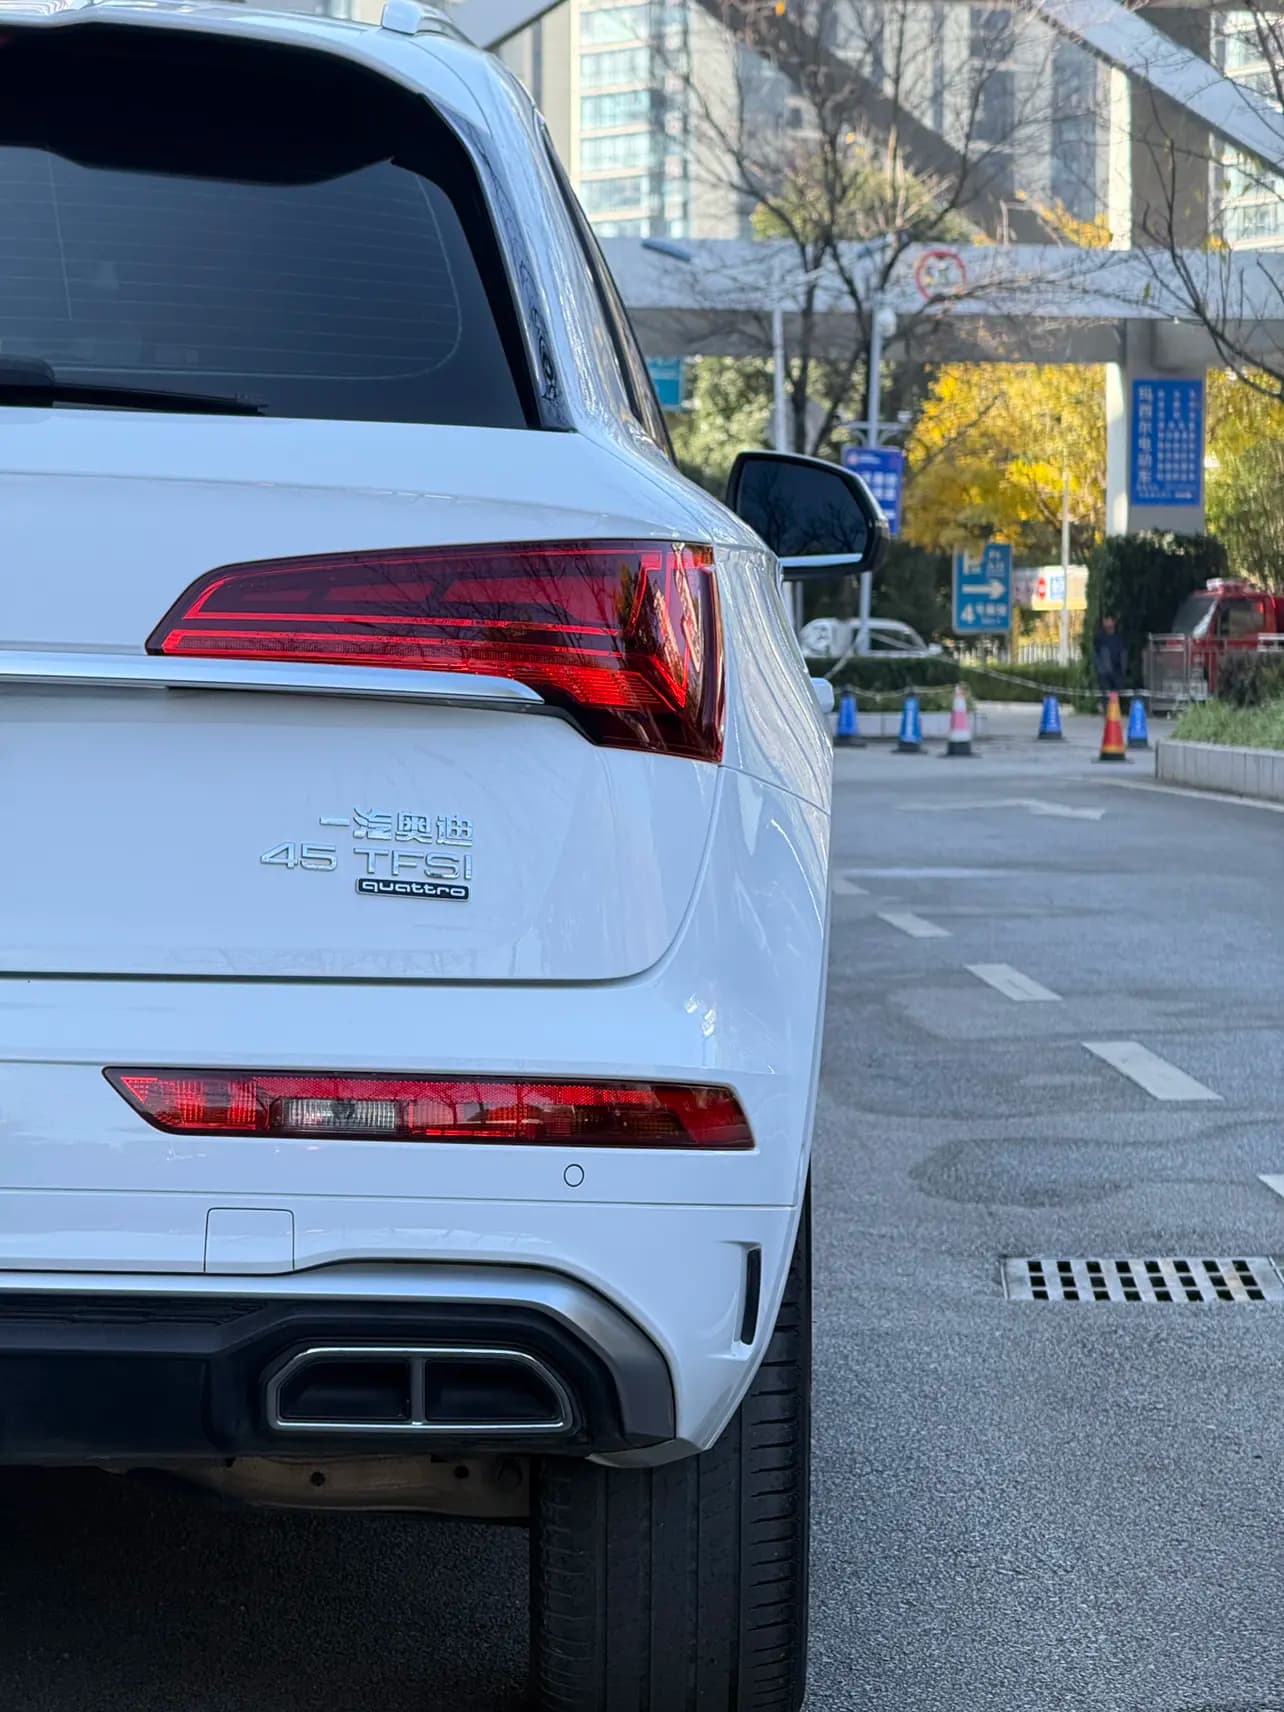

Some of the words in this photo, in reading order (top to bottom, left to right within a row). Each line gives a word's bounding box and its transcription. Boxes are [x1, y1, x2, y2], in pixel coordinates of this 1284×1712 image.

[319, 807, 473, 847] 一汽奥迪
[260, 841, 337, 872] 45
[353, 847, 473, 881] TFSI
[361, 880, 466, 897] quattro
